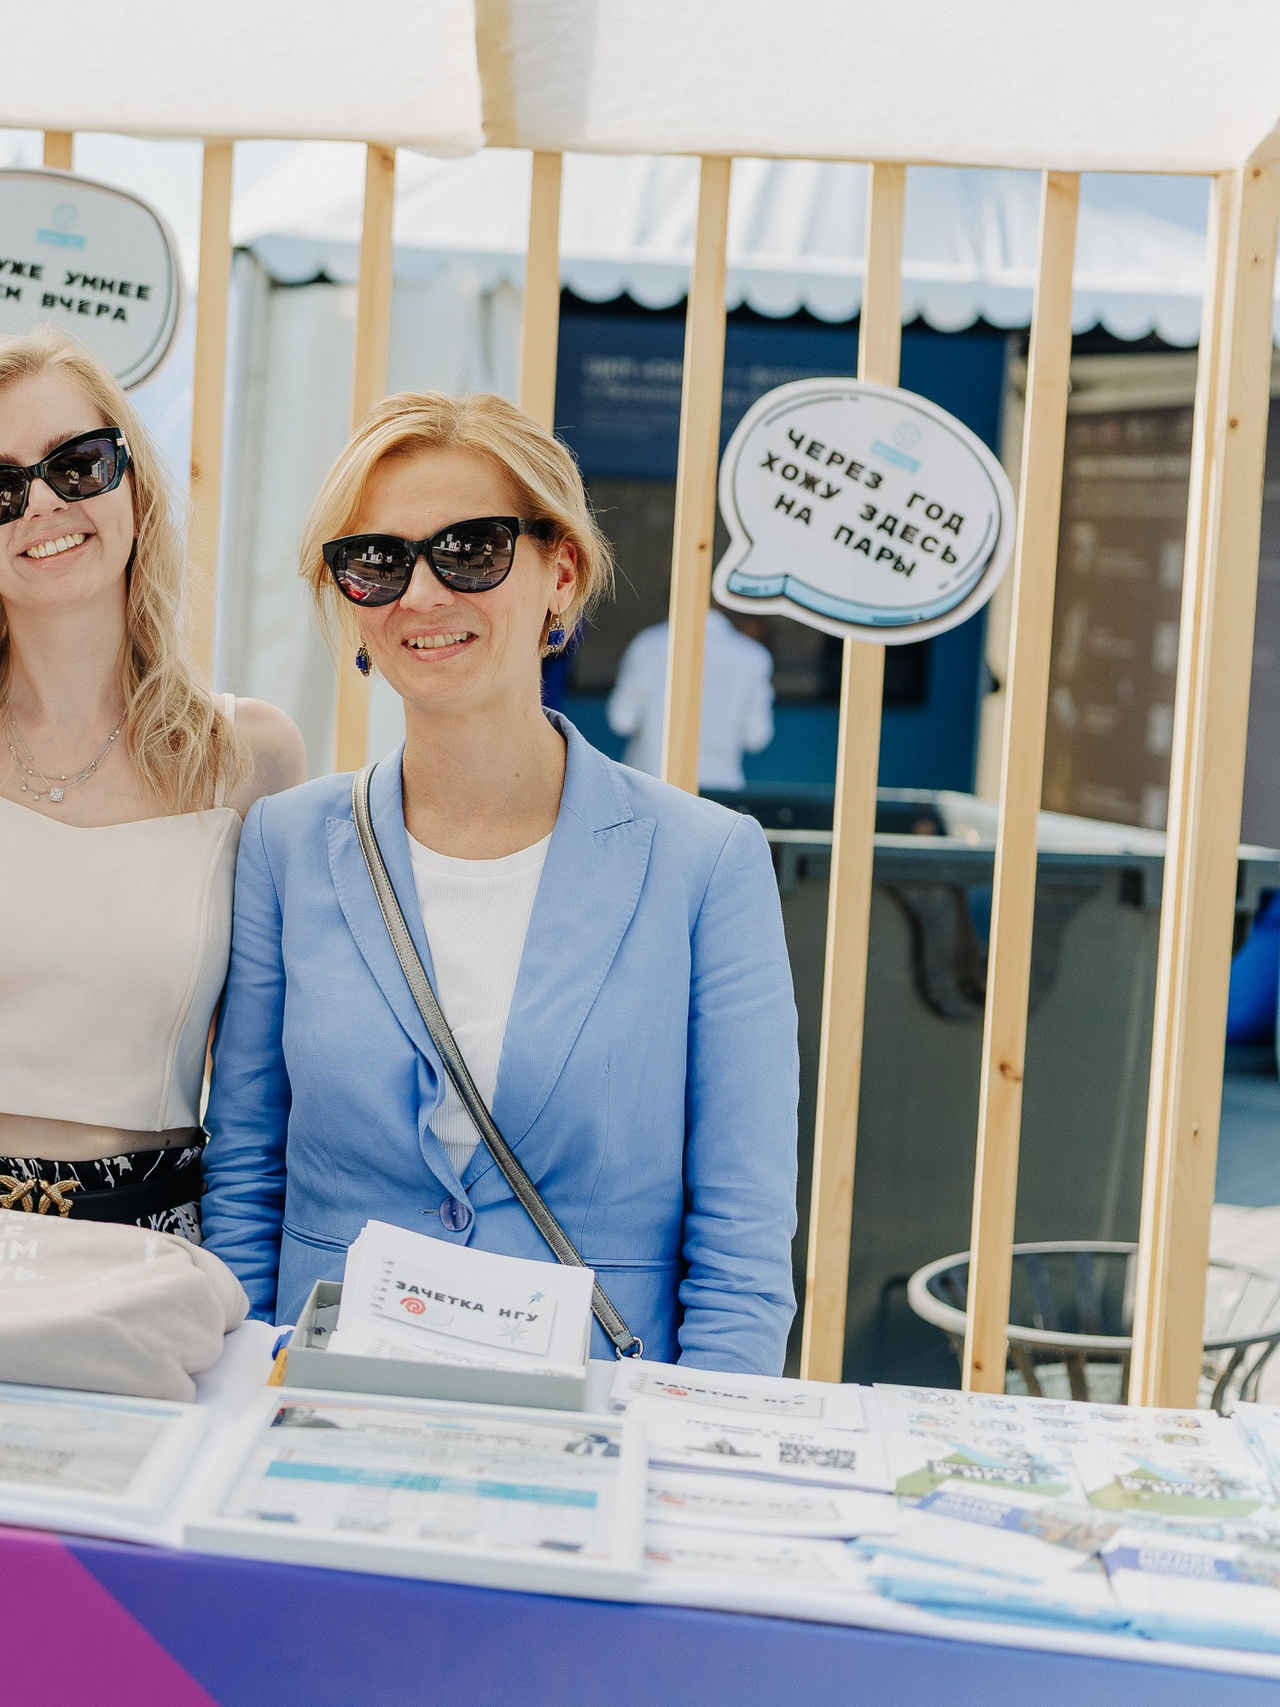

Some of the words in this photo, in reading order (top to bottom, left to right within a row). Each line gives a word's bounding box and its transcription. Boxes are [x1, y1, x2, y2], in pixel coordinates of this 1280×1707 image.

[41, 292, 128, 322] ВЧЕРА
[65, 270, 151, 301] УМНЕЕ
[760, 452, 841, 500] ХОЖУ
[859, 504, 959, 564] ЗДЕСЬ
[787, 428, 884, 490] ЧЕРЕЗ
[907, 492, 965, 536] ГОД
[774, 494, 813, 525] НА
[833, 525, 916, 578] ПАРЫ
[396, 1280, 484, 1313] ЗАЧЕТКА
[499, 1307, 539, 1322] НГУ
